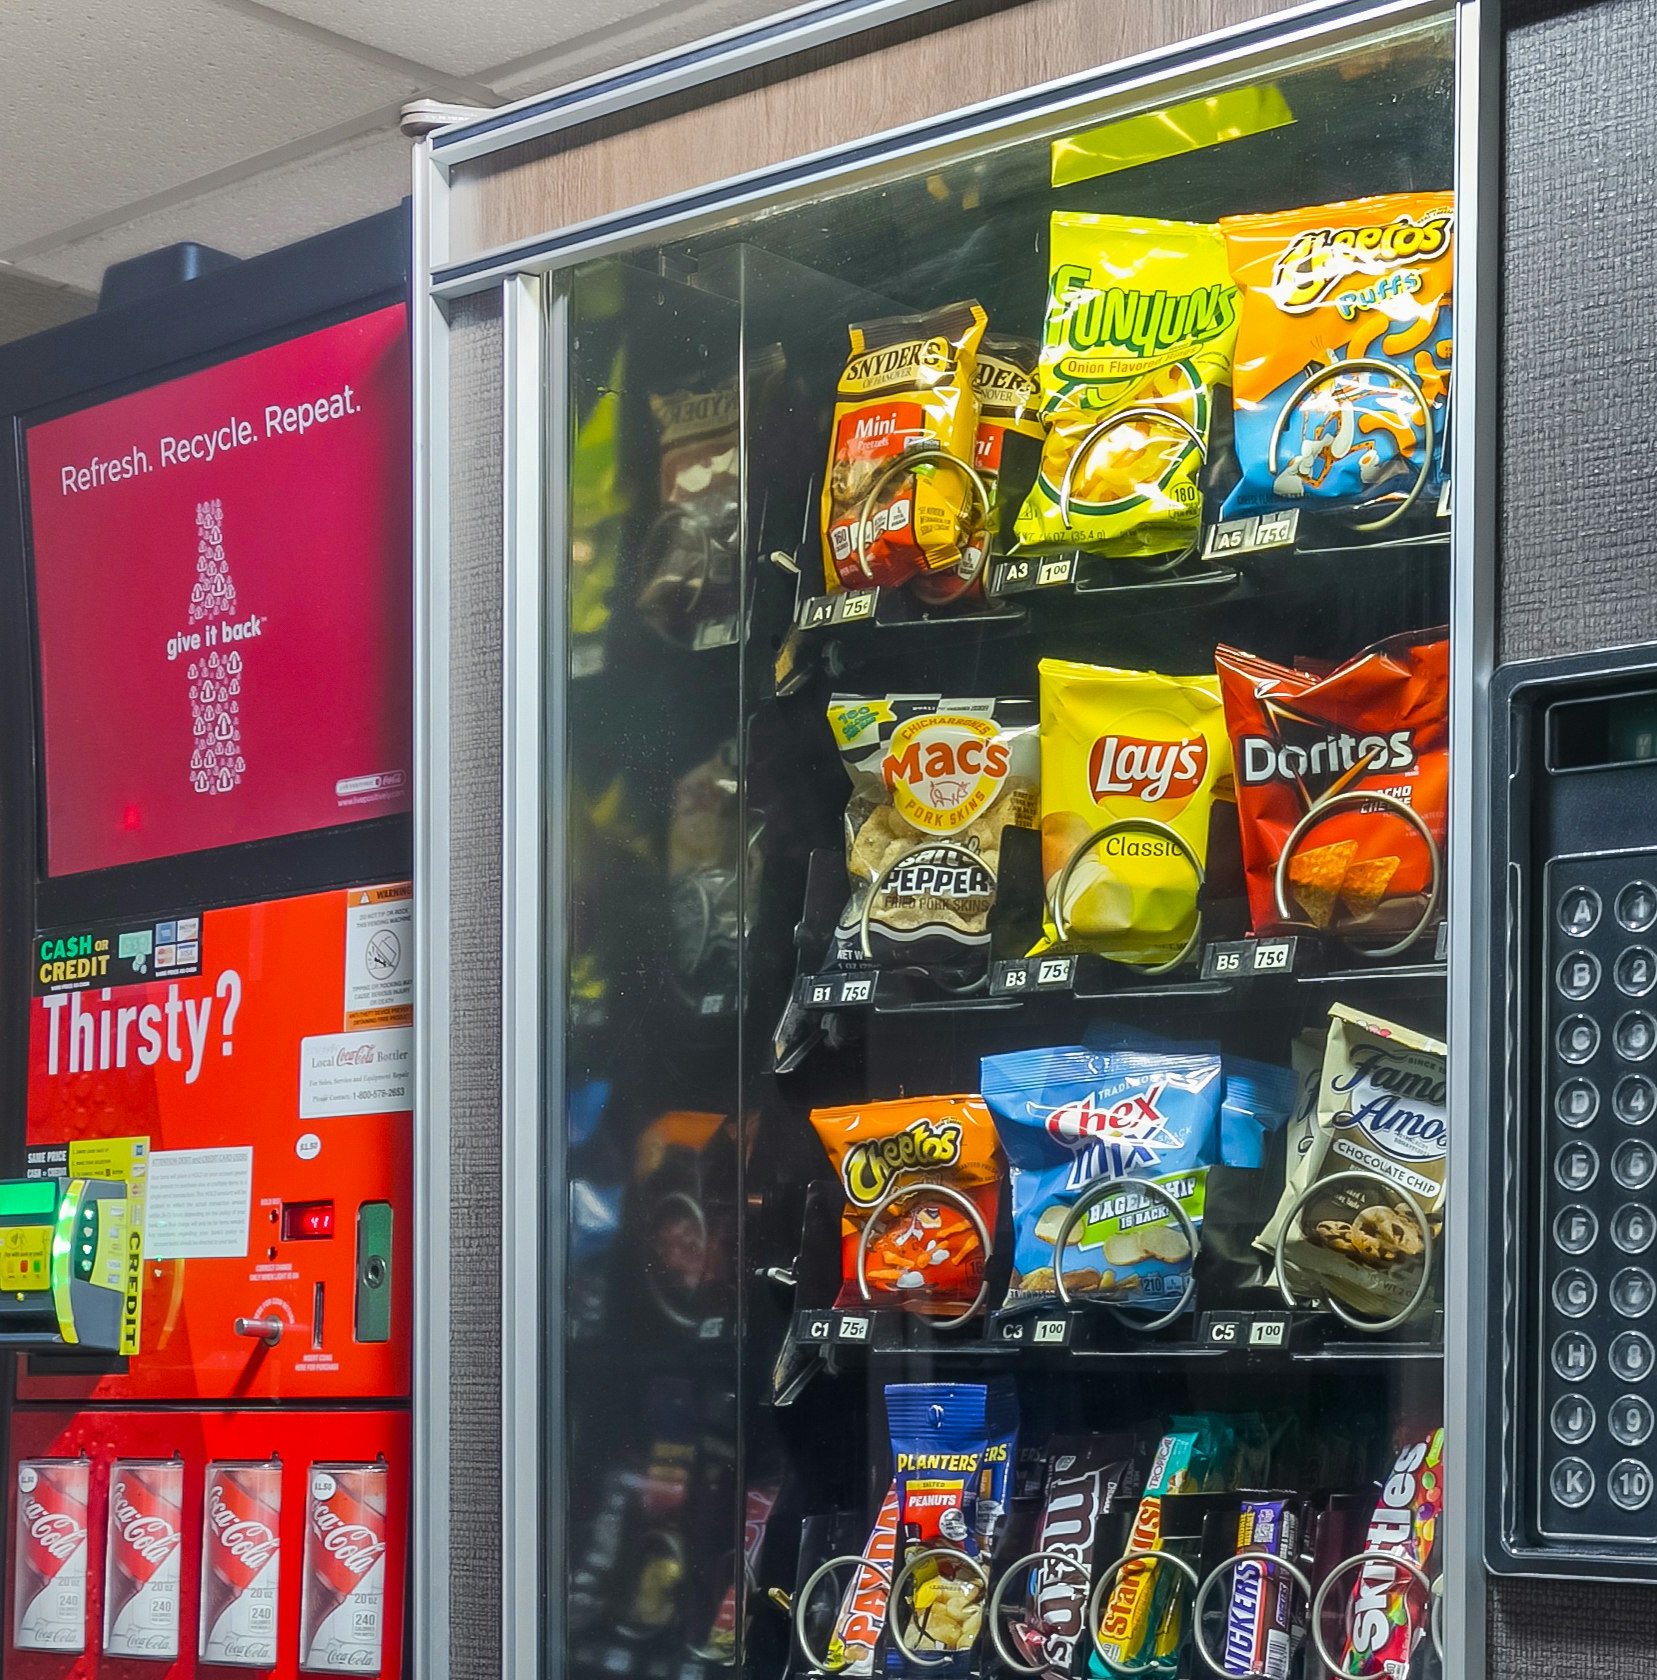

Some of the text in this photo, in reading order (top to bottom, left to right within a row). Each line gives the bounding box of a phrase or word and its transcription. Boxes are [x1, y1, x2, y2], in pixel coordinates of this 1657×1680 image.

[1069, 356, 1162, 374] Onion Flavored
[855, 413, 897, 439] Mini
[61, 385, 361, 495] Refresh. Recycle. Repeat.
[1174, 486, 1195, 502] 180
[1218, 531, 1242, 548] A5
[1006, 562, 1029, 579] A3
[813, 604, 833, 621] A1
[167, 614, 262, 661] give it back
[901, 715, 992, 741] CHICHARRONES
[883, 739, 1011, 793] Mac's
[1244, 730, 1415, 783] Doritos
[1095, 737, 1204, 802] Lay's
[905, 800, 943, 827] PORK
[950, 791, 986, 825] SKINS
[1106, 837, 1185, 857] Classic
[882, 867, 991, 896] PEPPER
[919, 897, 989, 912] PORK SKINS
[1573, 900, 1592, 923] A
[94, 939, 109, 952] OR
[40, 955, 110, 983] CREDIT
[1217, 954, 1240, 970] B5
[1006, 971, 1027, 986] B3
[1573, 960, 1647, 987] B 2
[813, 985, 831, 1001] B1
[42, 969, 242, 1085] Thirsty?
[312, 1049, 409, 1068] Local Bottler
[1571, 1088, 1644, 1114] D 4
[847, 1120, 960, 1204] Cheetos
[1338, 1142, 1437, 1195] CHOCOLATE CHIP
[1571, 1153, 1644, 1178] E 5
[1089, 1191, 1148, 1226] BAGEL
[1119, 1216, 1133, 1230] IS
[1570, 1216, 1643, 1241] F 6
[126, 1231, 141, 1347] CREDIT
[1568, 1280, 1643, 1304] G 7
[811, 1322, 829, 1337] C1
[1003, 1325, 1023, 1340] C3
[1211, 1324, 1235, 1341] C5
[1568, 1344, 1642, 1369] H 8
[1568, 1406, 1641, 1432] J 9
[897, 1453, 977, 1473] PLANTERS
[1148, 1437, 1174, 1491] TROPICAL
[1566, 1470, 1646, 1497] K 10
[909, 1494, 957, 1507] PEANUTS
[58, 1578, 70, 1587] 20
[152, 1582, 163, 1591] 20
[59, 1596, 78, 1606] 240
[251, 1588, 263, 1598] 20
[354, 1594, 367, 1604] 20
[152, 1601, 171, 1612] 240
[252, 1608, 271, 1619] 240
[355, 1614, 375, 1626] 240
